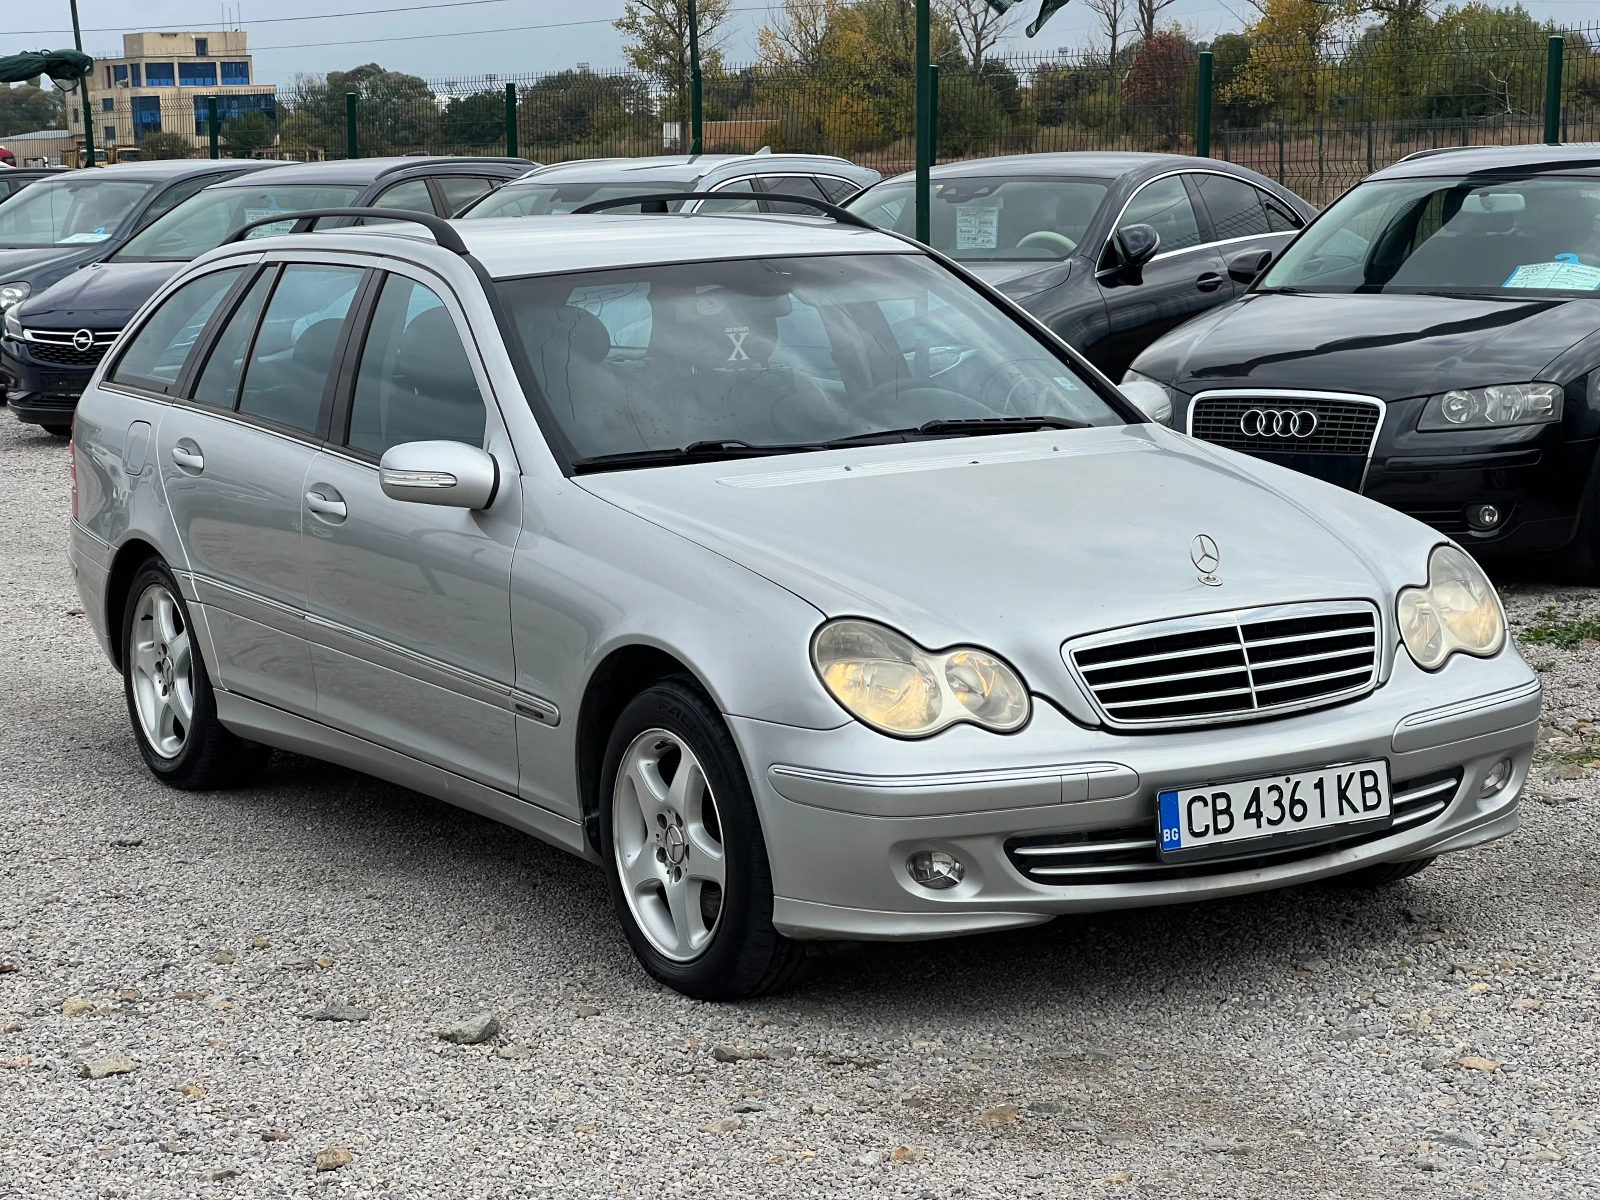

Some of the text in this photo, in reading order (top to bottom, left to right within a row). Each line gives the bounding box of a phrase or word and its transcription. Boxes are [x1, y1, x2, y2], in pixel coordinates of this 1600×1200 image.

[725, 333, 751, 361] X
[1186, 769, 1382, 838] CB 4361 KB
[1162, 827, 1179, 842] BG
